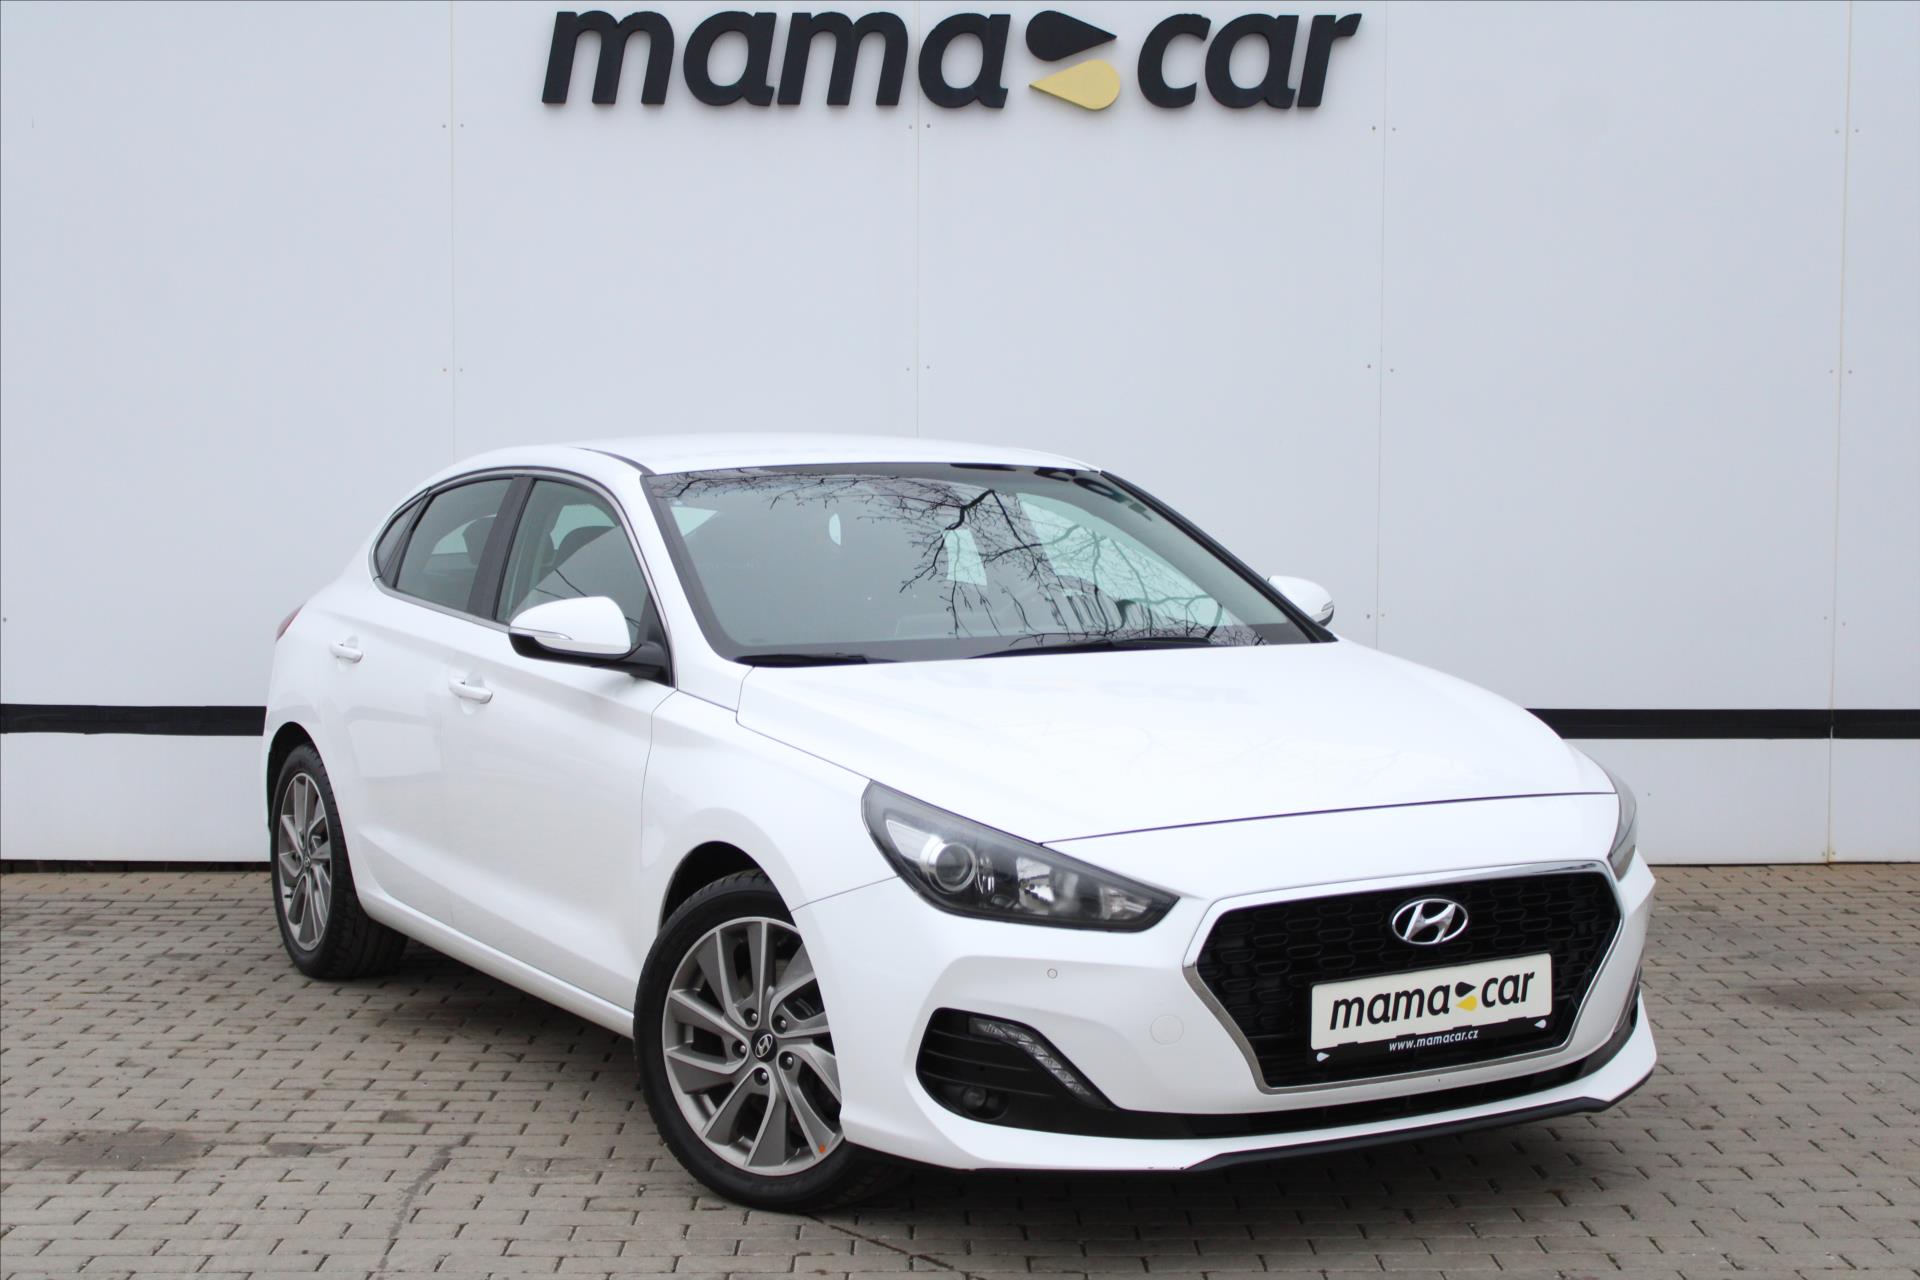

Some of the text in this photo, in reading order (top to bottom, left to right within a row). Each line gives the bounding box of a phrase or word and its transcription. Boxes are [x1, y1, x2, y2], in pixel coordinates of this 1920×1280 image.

[542, 11, 1363, 111] mama car
[1330, 971, 1535, 1030] mama car
[1389, 1029, 1479, 1052] www.mamacar.cz
